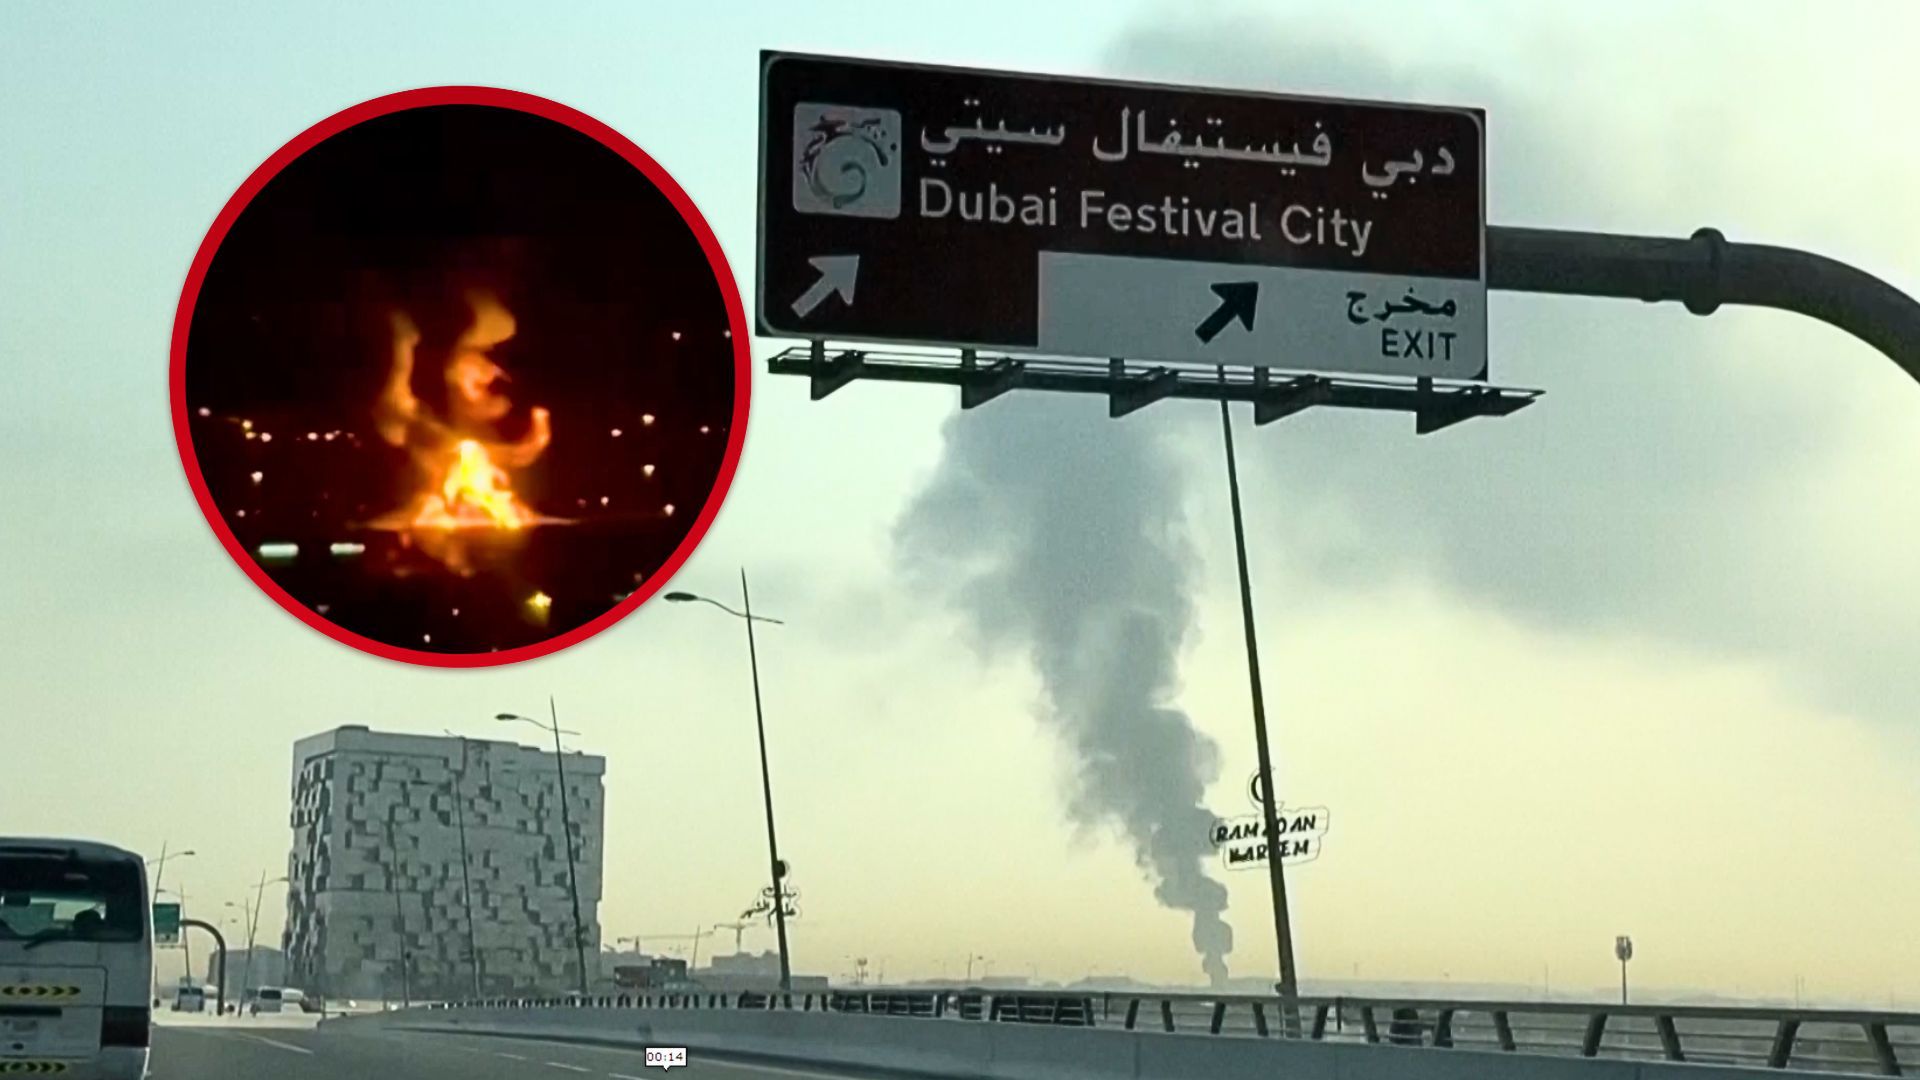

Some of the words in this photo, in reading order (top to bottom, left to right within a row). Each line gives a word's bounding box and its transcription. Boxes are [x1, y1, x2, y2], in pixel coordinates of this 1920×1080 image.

[920, 98, 1066, 168] سيتي
[1092, 105, 1332, 177] فيستيفال
[1361, 146, 1456, 200] دبي
[919, 176, 1057, 227] Dubai
[1080, 189, 1262, 241] Festival
[1280, 204, 1373, 257] City
[1345, 286, 1457, 325] مخرج
[1381, 327, 1458, 361] EXIT
[1229, 839, 1310, 864] KAREM
